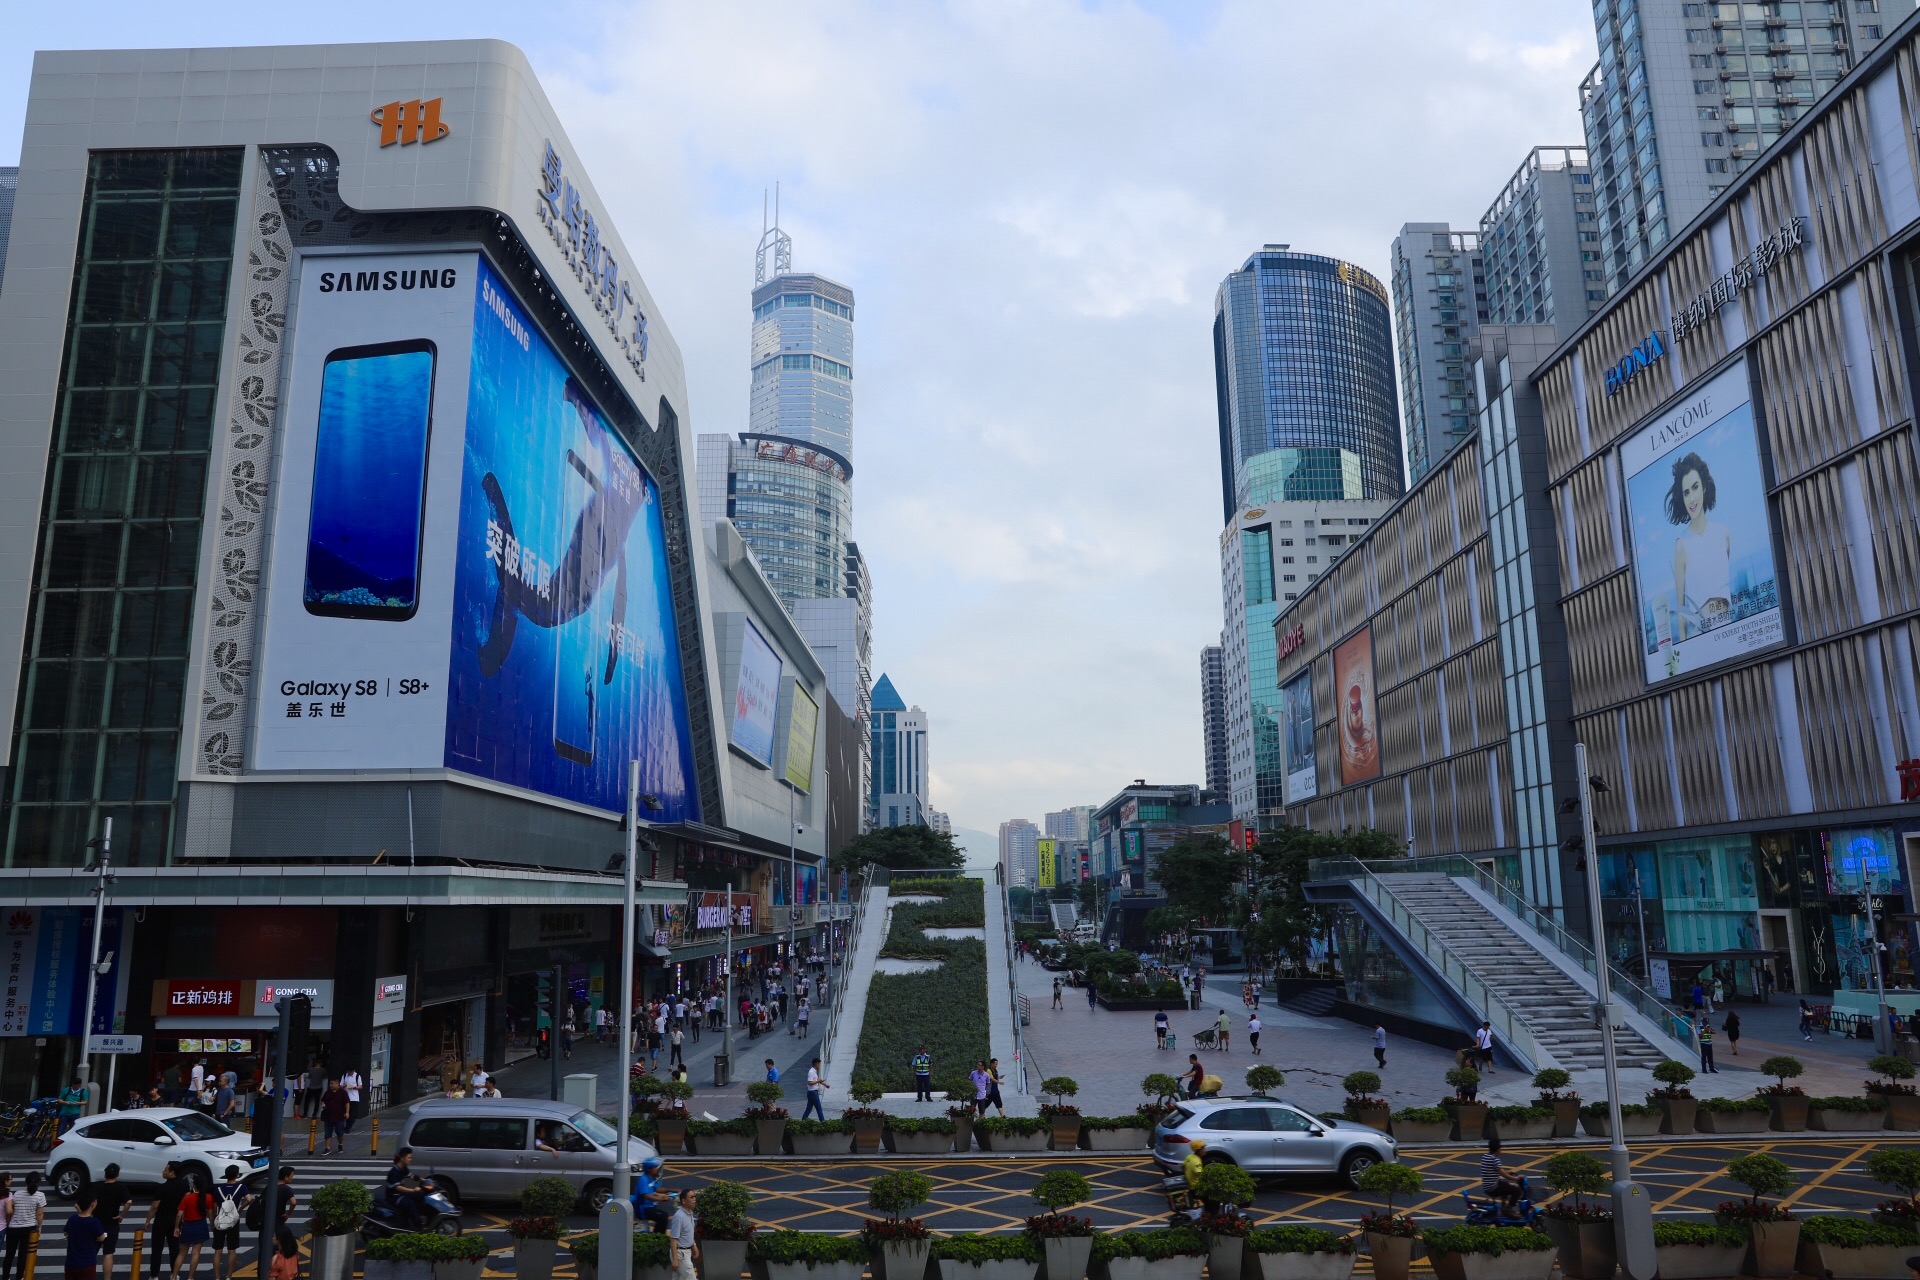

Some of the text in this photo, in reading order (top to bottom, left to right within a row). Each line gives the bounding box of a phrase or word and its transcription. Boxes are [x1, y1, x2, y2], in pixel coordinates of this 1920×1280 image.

[537, 138, 649, 362] 曼哈数码广场
[320, 269, 456, 292] SAMSUNG
[1671, 216, 1803, 344] 博纳国际影城
[483, 279, 530, 352] SAMSUNG
[584, 276, 620, 343] DIGITAL
[621, 336, 645, 383] PLAZA
[1603, 331, 1664, 398] BONA
[1650, 395, 1712, 451] LANCÔME
[612, 451, 633, 487] Galaxy
[612, 470, 631, 505] 盖乐世
[485, 519, 551, 602] 突破所限
[606, 614, 646, 670] 大有可能
[1721, 625, 1741, 639] EXPERT
[1741, 619, 1759, 631] YOUTH
[1759, 612, 1780, 625] SHIELD
[280, 678, 429, 700] Galaxy S8 S8+
[286, 702, 346, 718] 盖乐世
[697, 906, 721, 929] BURGER
[2, 940, 23, 1032] 华为客户服务中心
[172, 989, 233, 1006] 正新鸡排
[275, 988, 317, 996] GONG CHA
[16, 1017, 24, 1032] 5楼
[102, 1038, 124, 1046] 振兴路
